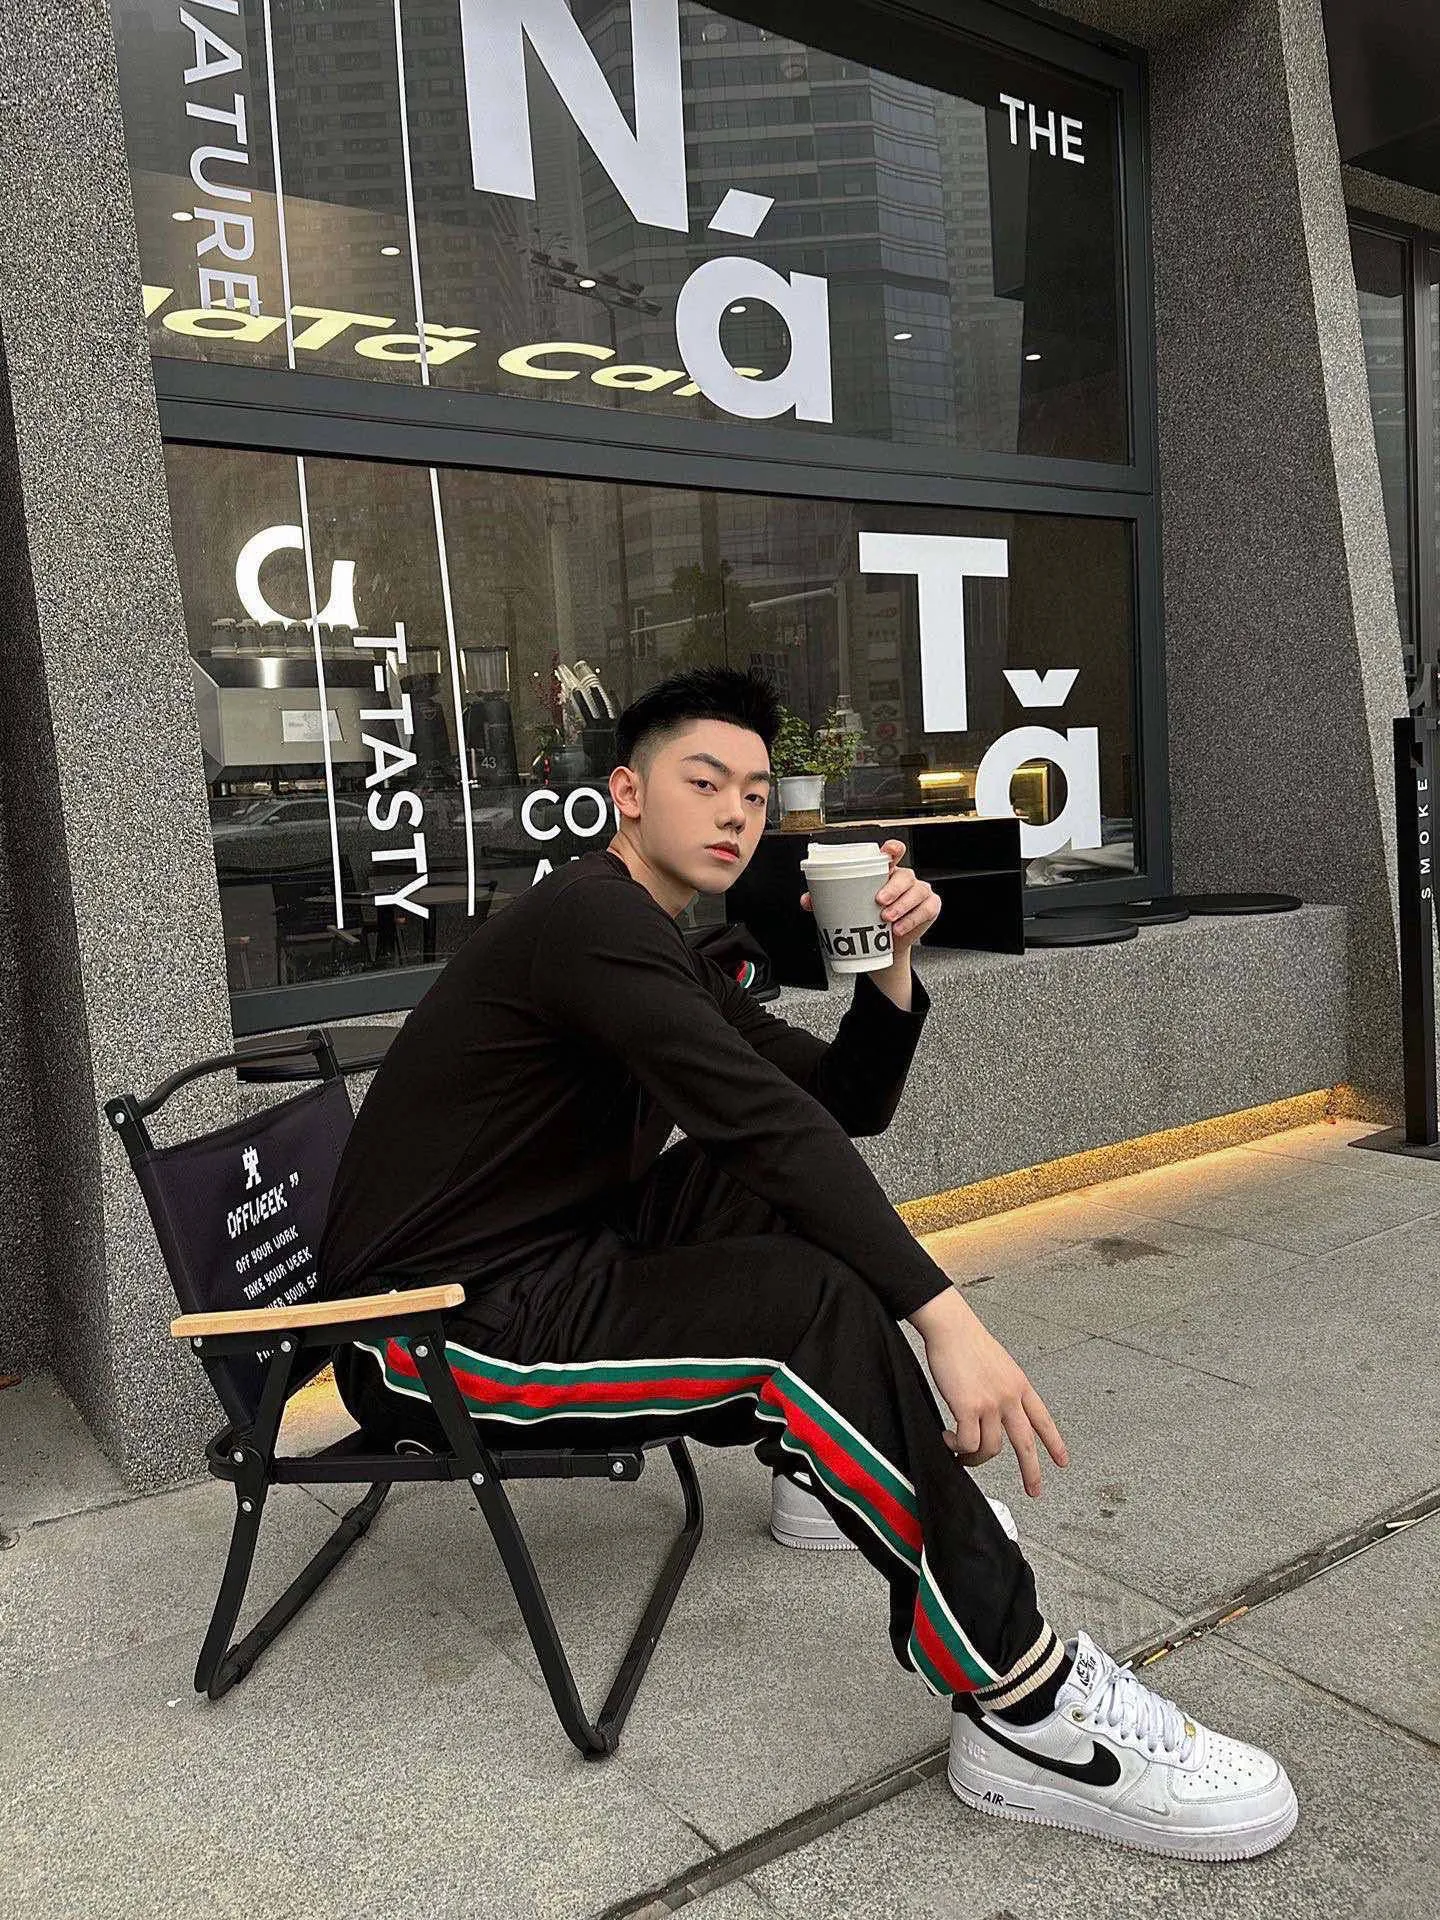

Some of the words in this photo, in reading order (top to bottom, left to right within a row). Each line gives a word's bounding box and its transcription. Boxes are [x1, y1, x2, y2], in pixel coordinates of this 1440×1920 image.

[1000, 93, 1086, 165] THE
[180, 0, 260, 316] ATURE
[142, 284, 481, 366] áTǎ
[353, 622, 430, 919] T-TASTY
[481, 757, 497, 769] 43
[521, 787, 621, 840] CO
[1417, 778, 1432, 899] SMOKE
[226, 1183, 288, 1239] OFFWEEK
[235, 1254, 251, 1274] OFF
[251, 1241, 274, 1264] YOUR
[272, 1225, 299, 1250] WORK
[243, 1277, 266, 1301] TAKE
[264, 1263, 288, 1287] YOUR
[285, 1246, 313, 1271] WEEK
[284, 1281, 308, 1304] YOUR
[982, 1790, 1005, 1807] AIR
